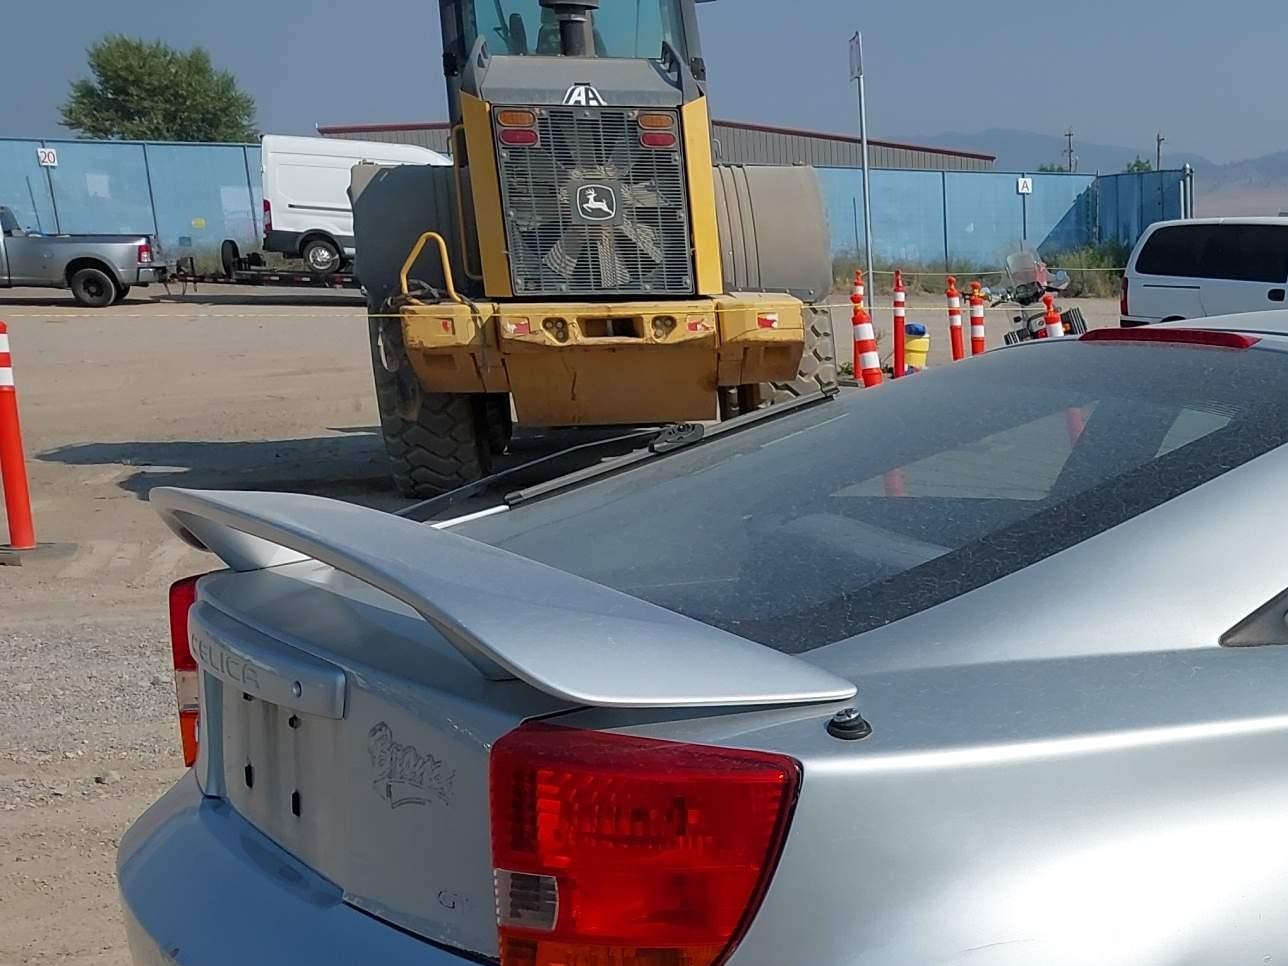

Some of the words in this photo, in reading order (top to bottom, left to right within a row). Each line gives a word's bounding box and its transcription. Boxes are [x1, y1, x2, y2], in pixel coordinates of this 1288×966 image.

[39, 150, 56, 164] 20
[1020, 179, 1030, 192] A
[191, 633, 260, 689] CELICA
